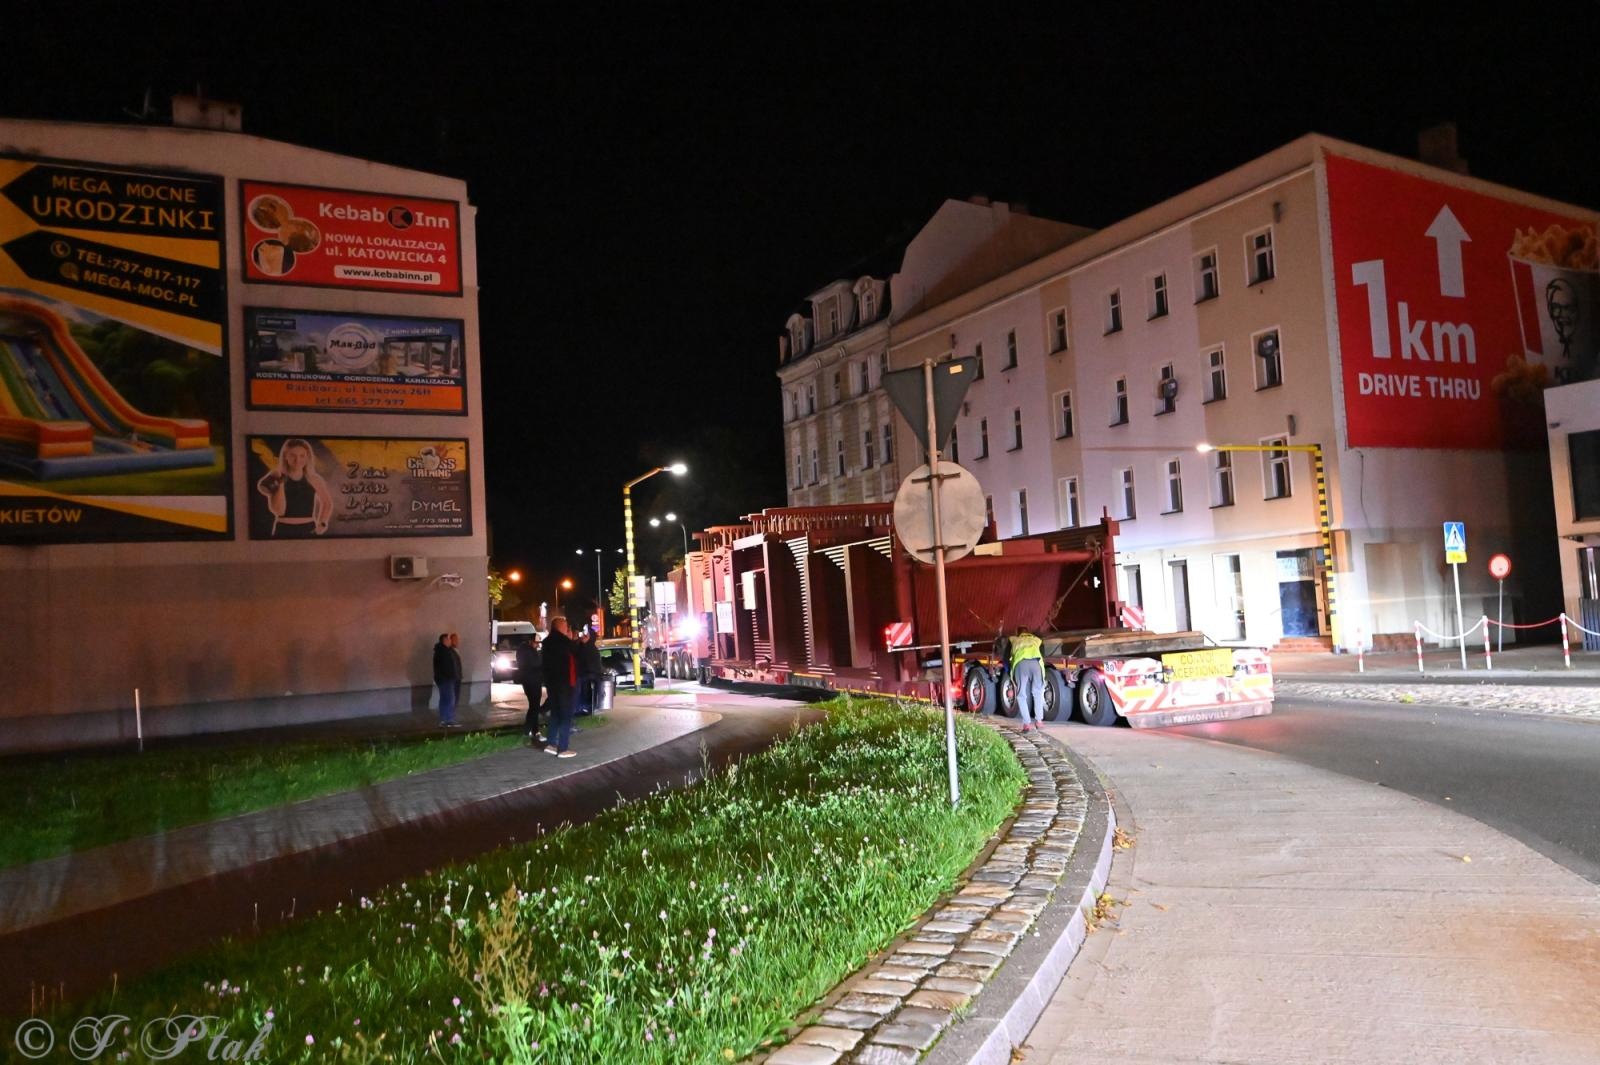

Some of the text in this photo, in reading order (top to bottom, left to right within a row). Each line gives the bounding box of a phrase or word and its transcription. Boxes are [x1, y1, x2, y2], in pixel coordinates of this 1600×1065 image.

[52, 175, 197, 203] MEGA MOCNE
[32, 195, 215, 231] URODZINKI
[319, 202, 385, 223] Kebab
[415, 211, 450, 229] Inn
[325, 233, 446, 251] NOWA LOKALIZACJA
[325, 247, 447, 265] ul. KATOWICKA 4
[343, 268, 433, 283] www.kebabinn.pl
[84, 270, 199, 308] MEGA-MOC.PL
[1358, 372, 1481, 400] DRIVE THRU
[0, 506, 82, 524] KIETÓW
[411, 500, 461, 512] DYMEL
